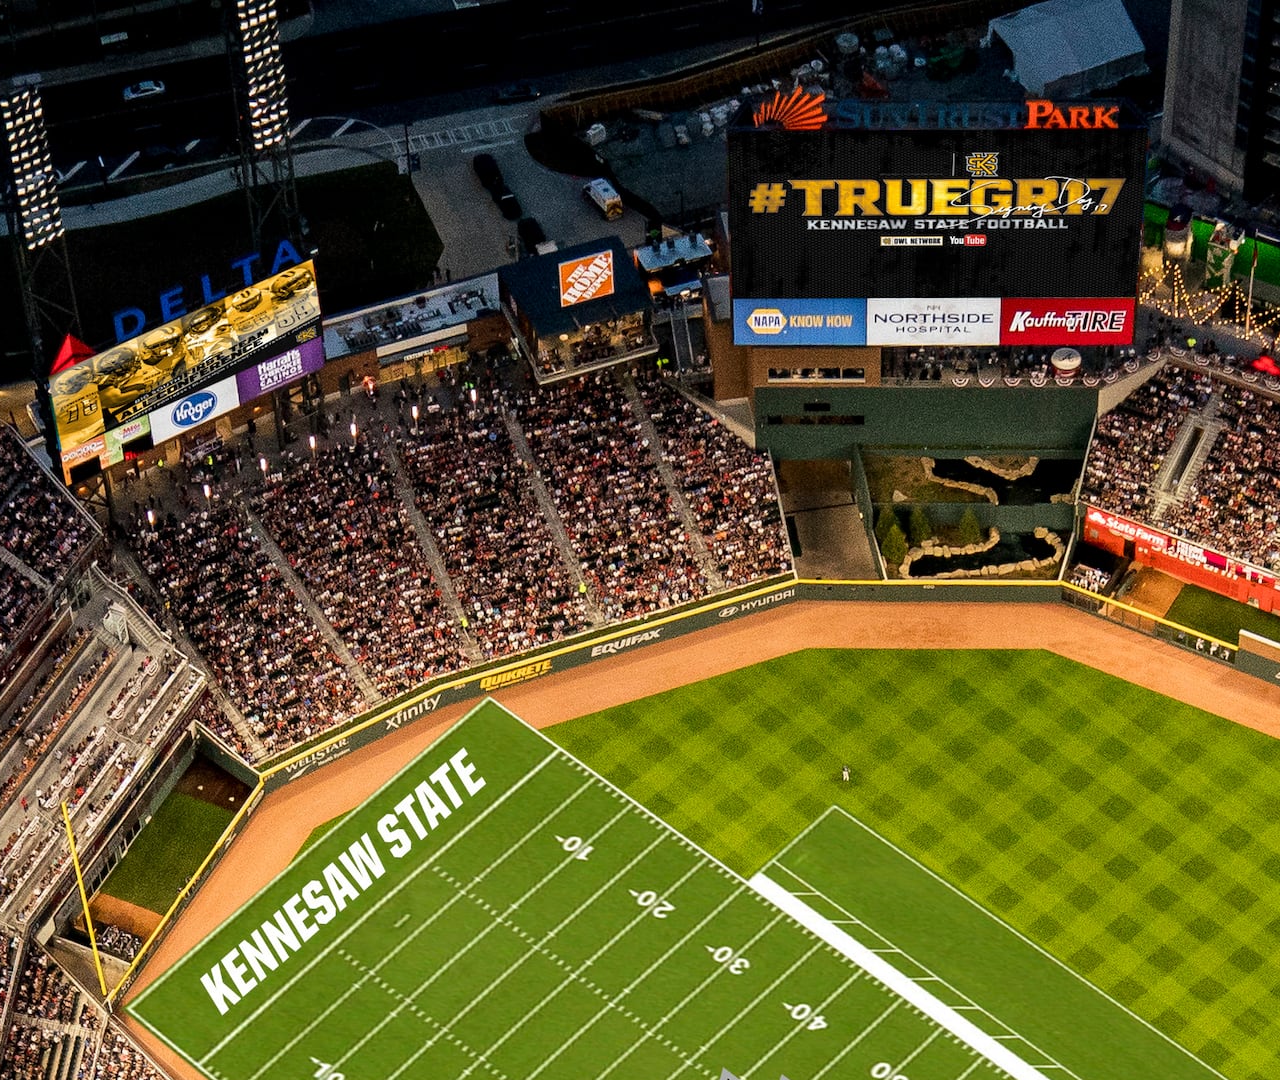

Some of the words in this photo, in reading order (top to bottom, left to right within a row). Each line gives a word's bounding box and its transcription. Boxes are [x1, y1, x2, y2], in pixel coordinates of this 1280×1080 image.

[1024, 99, 1119, 129] PARK
[806, 219, 907, 230] KENNESAW
[914, 219, 969, 230] STATE
[976, 219, 1068, 230] FOOTBALL
[562, 254, 609, 304] HOME
[566, 264, 588, 284] THE
[582, 268, 612, 300] DEPOT
[113, 239, 304, 344] DELTA
[754, 315, 782, 328] NAPA
[789, 315, 822, 328] KNOW
[826, 315, 853, 328] HOW
[873, 313, 994, 324] NORTHSIDE
[895, 325, 971, 333] HOSPITAL
[1067, 310, 1128, 333] TIRE
[230, 328, 269, 348] TEAM
[259, 366, 303, 388] CASINOS
[175, 397, 215, 423] Kroger
[741, 589, 796, 612] HYUNDAI
[591, 628, 662, 658] EQUIFAX
[480, 659, 553, 691] QUIKRETE
[384, 694, 442, 731] xfinity
[284, 738, 350, 774] WELLSTAR
[564, 836, 594, 861] 10
[200, 832, 386, 1016] KENNESAW
[377, 747, 487, 858] STATE
[637, 890, 675, 919] 20
[713, 946, 750, 975] 30
[791, 1003, 828, 1031] 40
